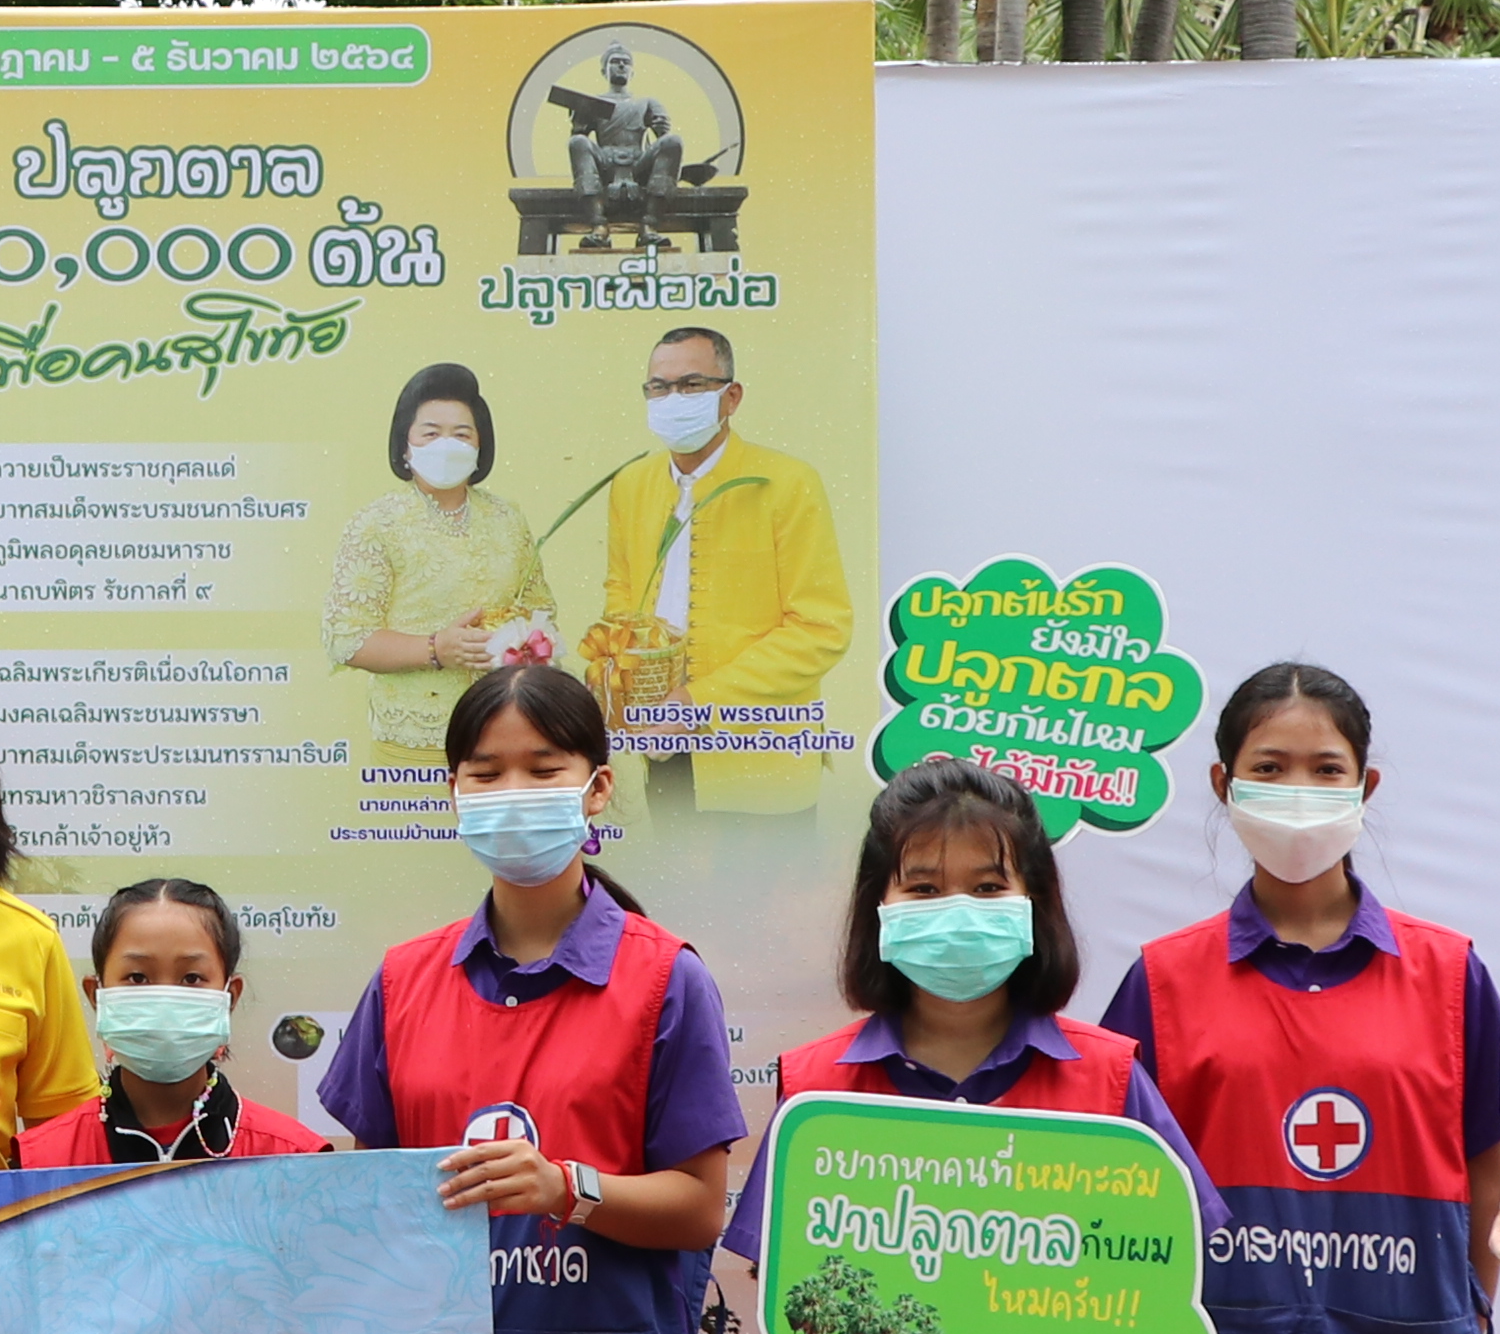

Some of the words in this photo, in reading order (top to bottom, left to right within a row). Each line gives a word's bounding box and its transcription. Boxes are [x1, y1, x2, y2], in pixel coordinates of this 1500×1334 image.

[134, 40, 155, 73] ๕
[165, 36, 298, 73] ธันวาคม
[309, 38, 414, 73] ๒๕๖๔
[14, 119, 322, 219] ปลูกตาล
[309, 197, 444, 288] ต้น
[480, 246, 778, 326] ปลูกเพื่อพ่อ
[104, 573, 187, 601] รัชกาลที่
[195, 581, 214, 601] ๙
[909, 578, 1123, 628] ปลูกต้นรัก
[1030, 618, 1150, 663] ยังมีใจ
[905, 640, 1174, 711] ปลูกตาล
[721, 701, 824, 723] พรรณเทวี
[920, 694, 1145, 753] ด้วยกันไหม
[605, 729, 854, 756] ว่าราชการจังหวัดสุโขทัย
[1, 783, 206, 807] ทรมหาวชิราลงกรณ
[9, 822, 171, 854] ชิรเกล้าเจ้าอยู่หัว
[1208, 1226, 1416, 1287] อาสายุวกาชาด
[983, 1269, 1141, 1328] ไหมครับ!!
